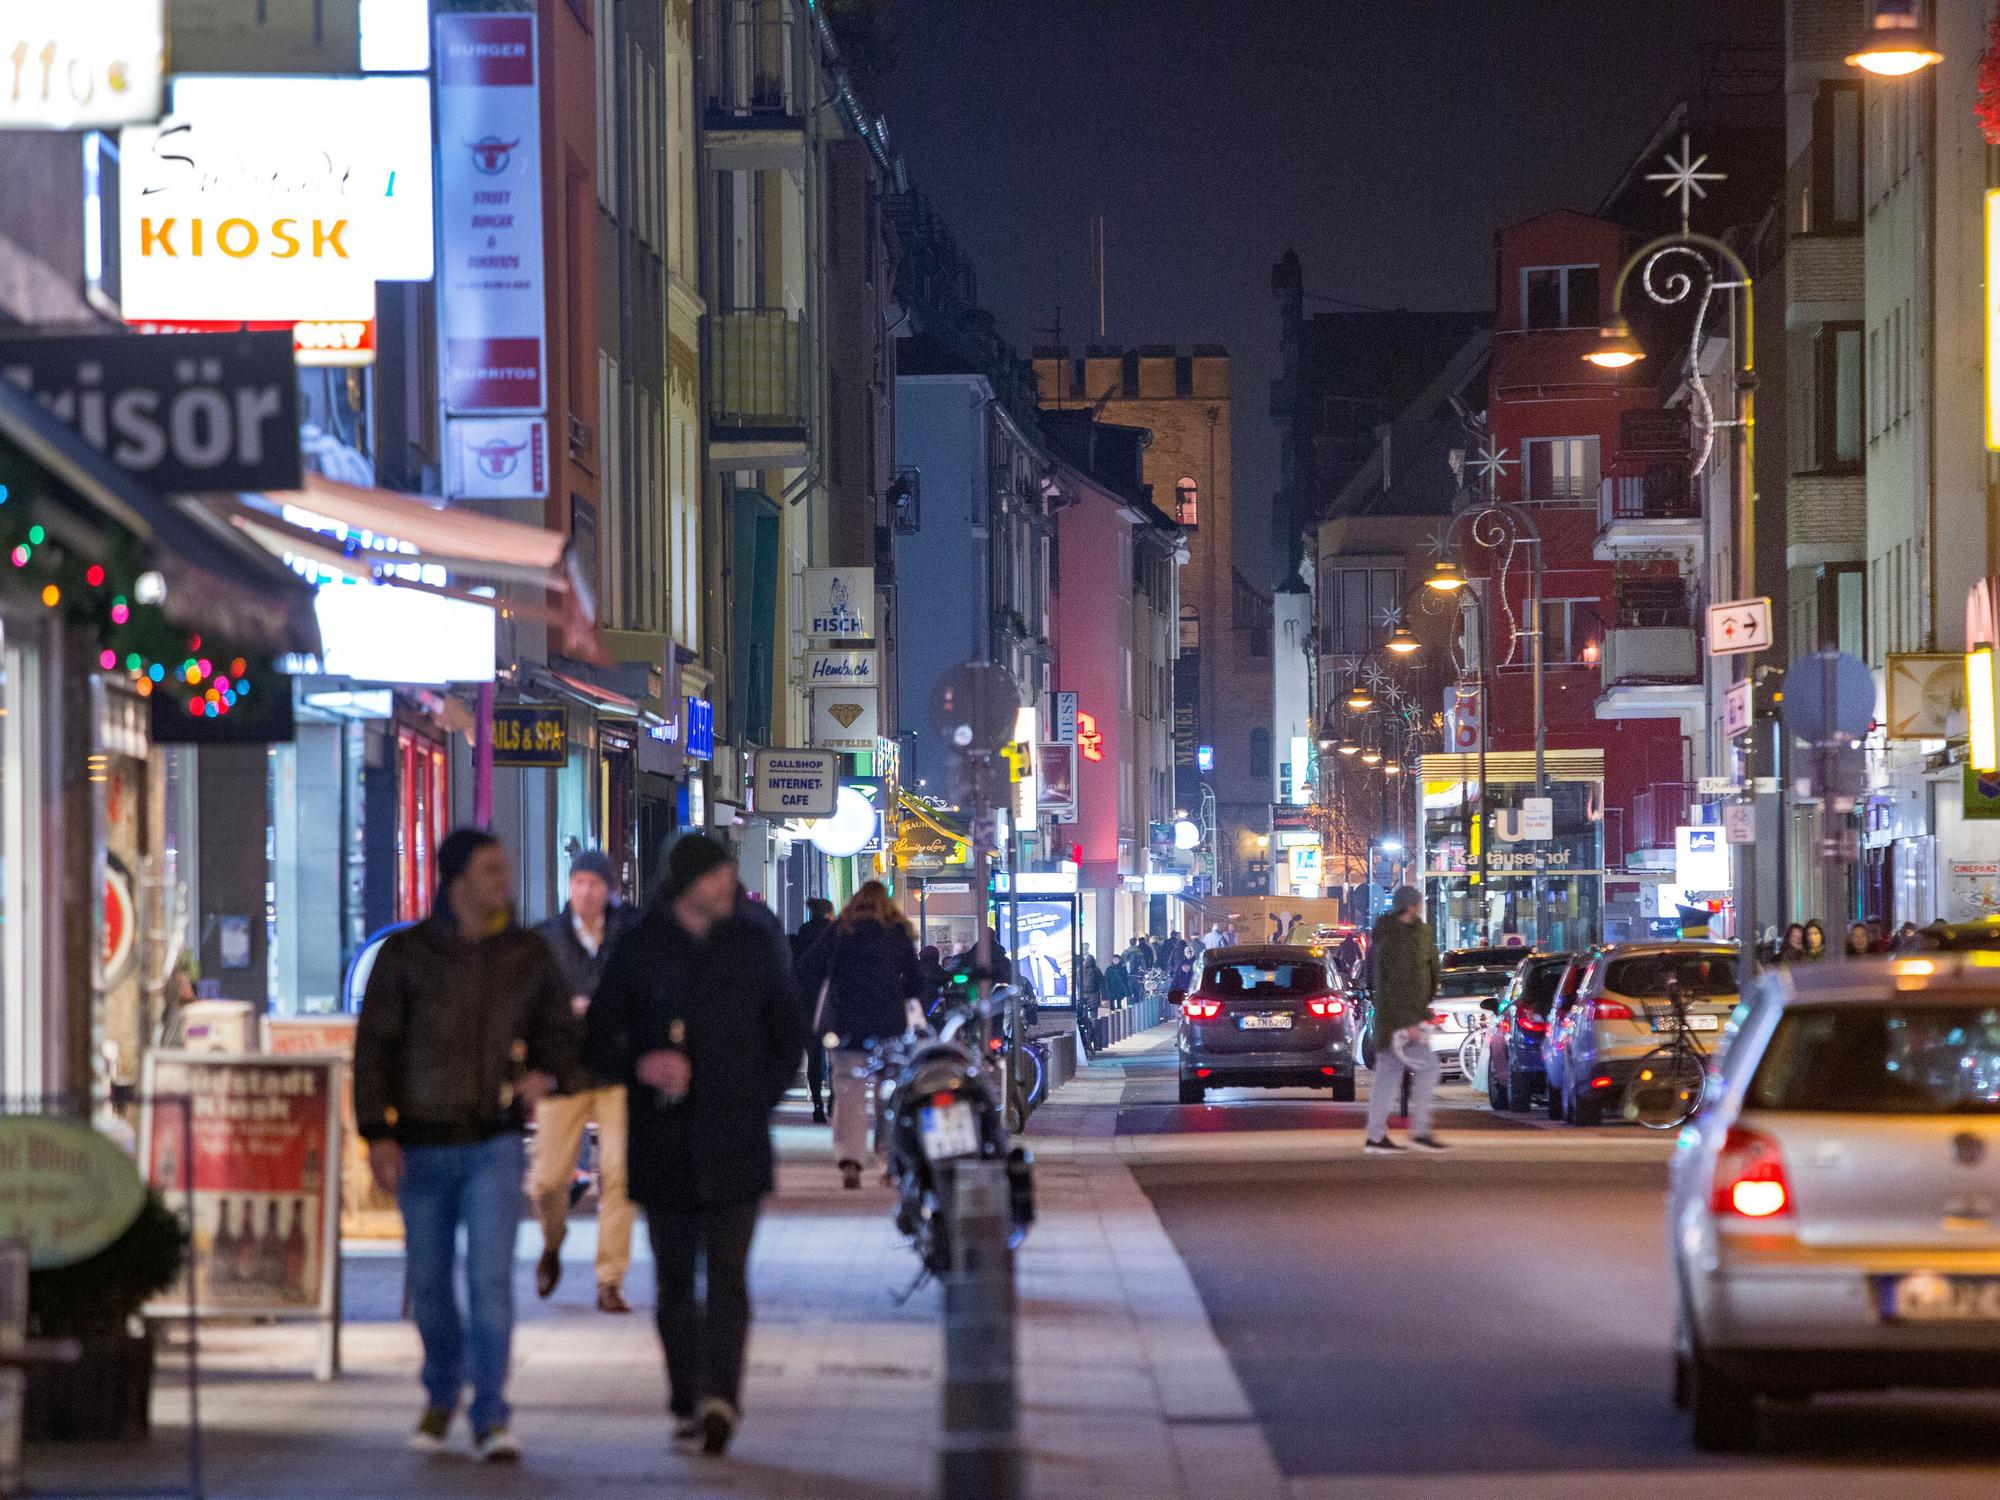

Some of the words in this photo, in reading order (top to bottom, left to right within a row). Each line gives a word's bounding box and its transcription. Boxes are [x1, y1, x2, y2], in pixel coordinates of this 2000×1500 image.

[141, 217, 350, 259] KIOSK
[813, 617, 864, 632] FISCH
[769, 760, 824, 769] CALLSHOP
[782, 794, 809, 806] CAFE
[1496, 808, 1524, 842] U
[1454, 849, 1570, 866] Katäusehof
